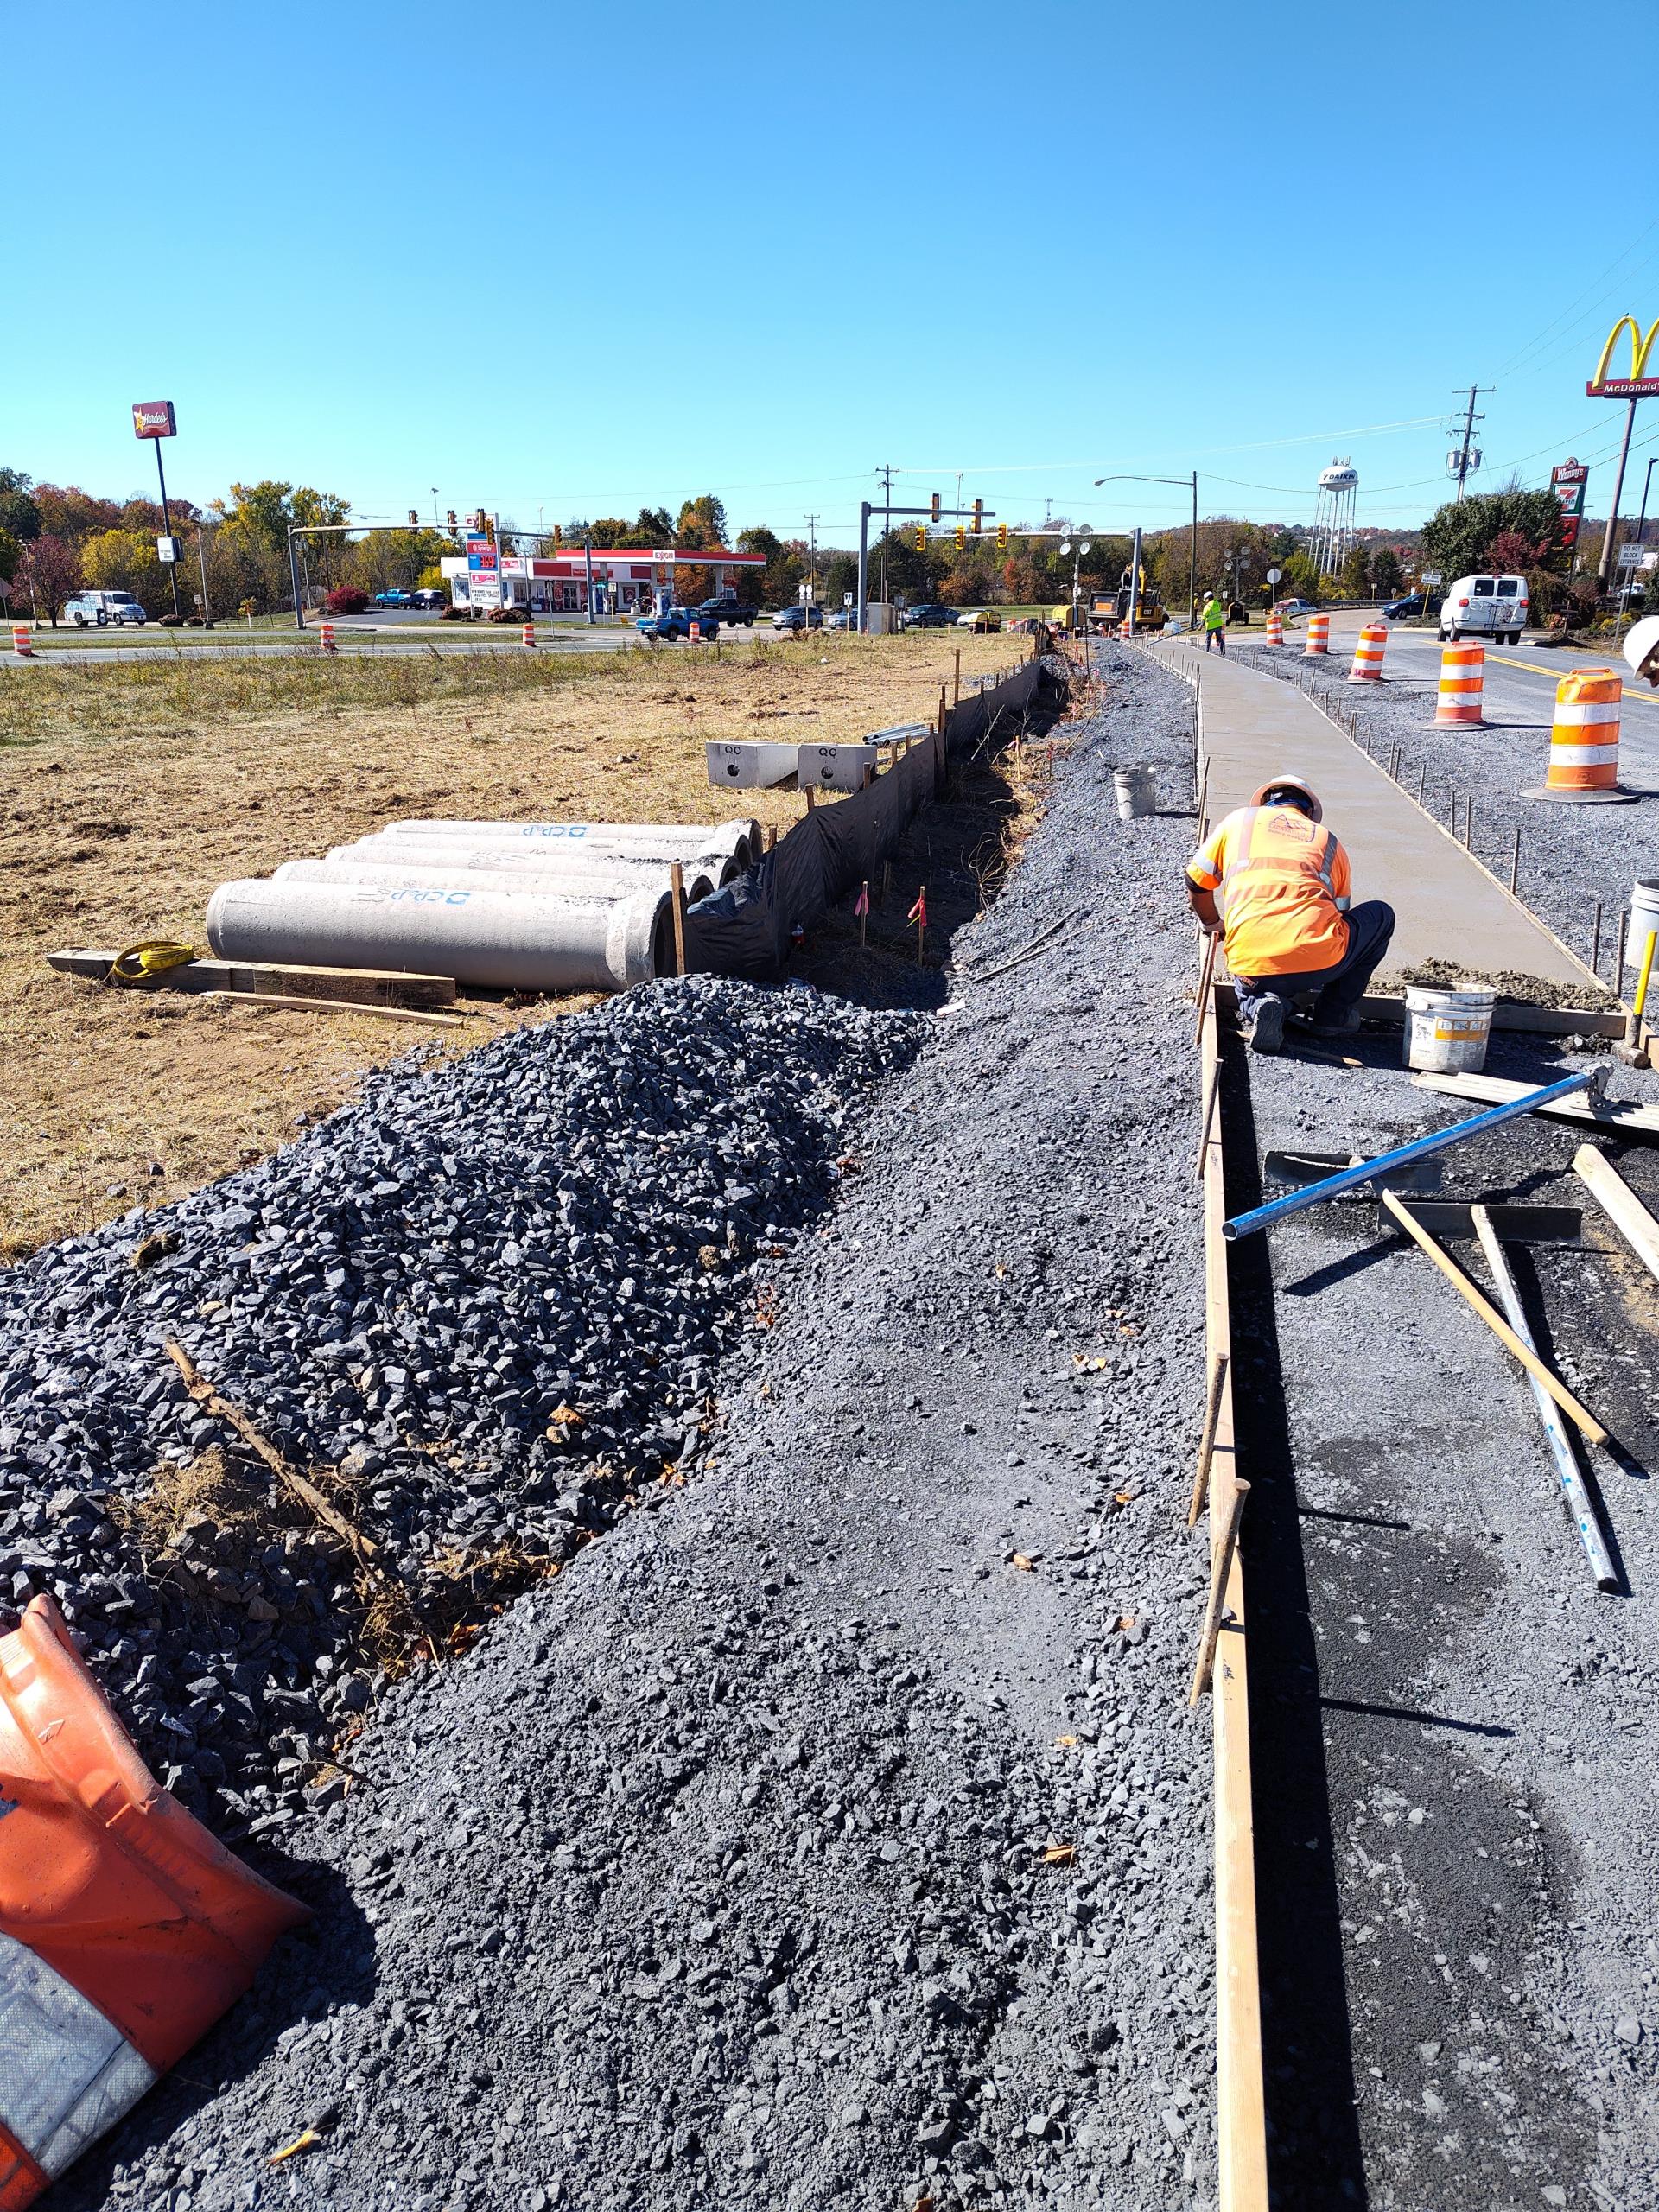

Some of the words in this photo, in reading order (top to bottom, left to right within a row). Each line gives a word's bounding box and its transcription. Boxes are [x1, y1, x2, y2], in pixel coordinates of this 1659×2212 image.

[143, 412, 168, 425] Hardee's
[655, 551, 674, 561] EXXON
[724, 746, 741, 755] QC
[818, 747, 837, 757] QC
